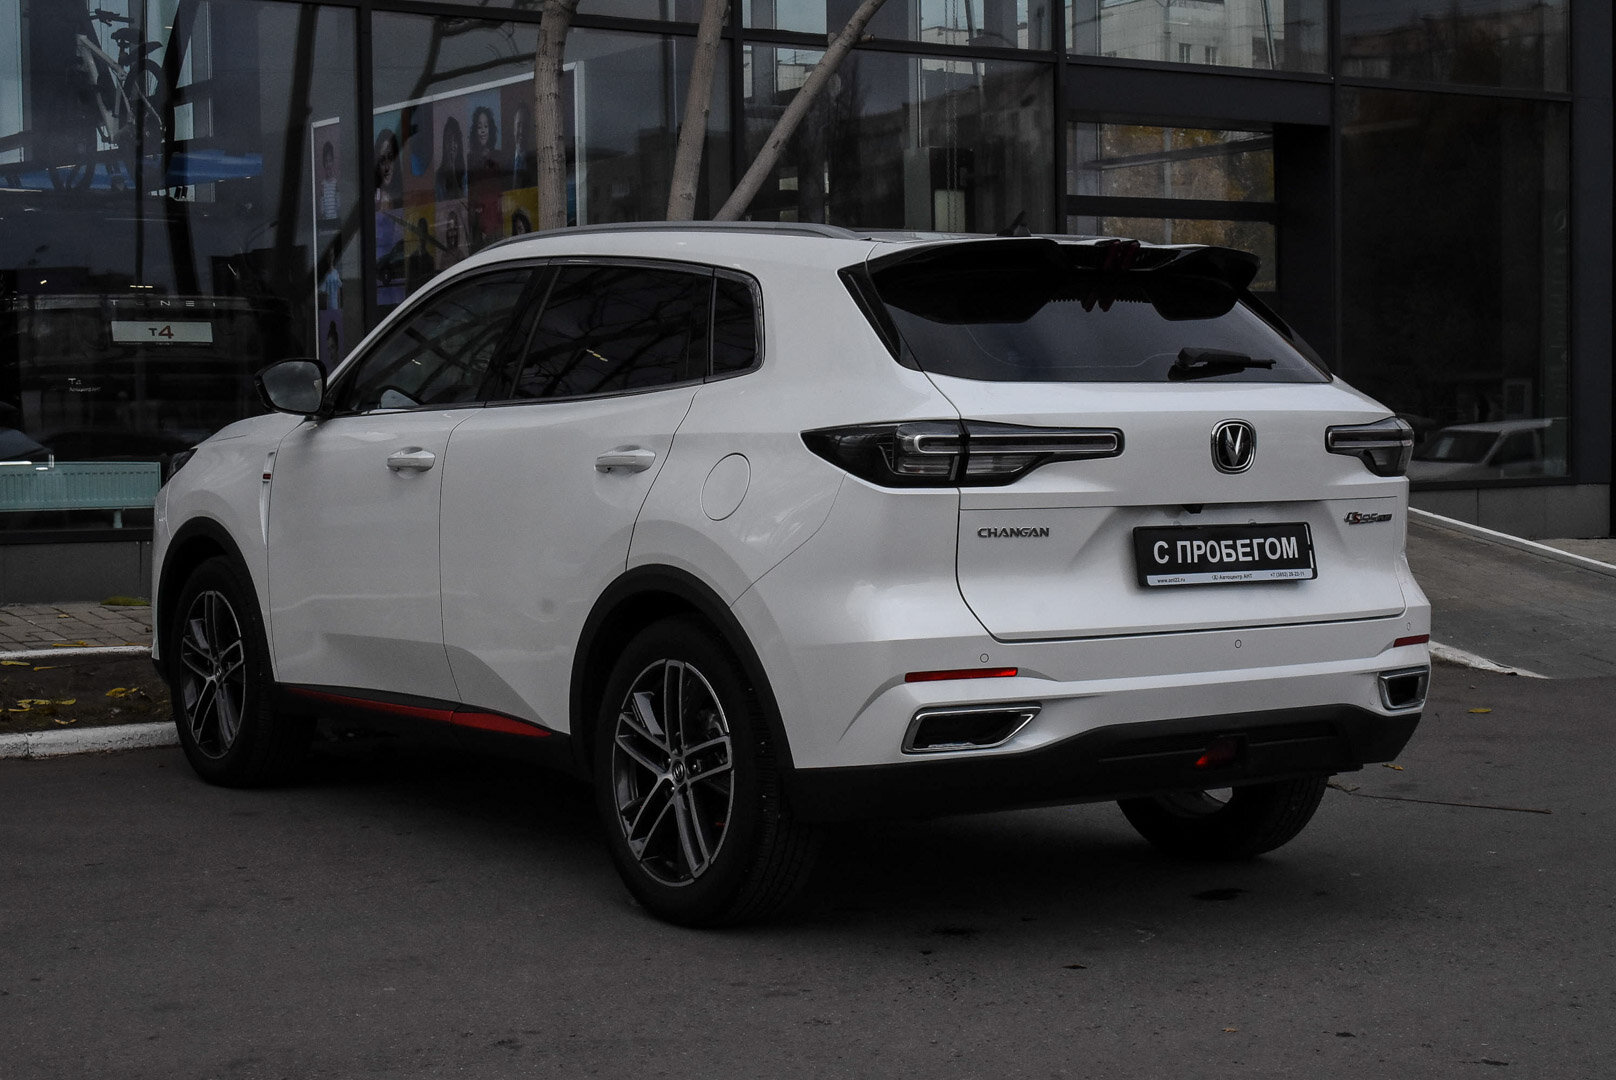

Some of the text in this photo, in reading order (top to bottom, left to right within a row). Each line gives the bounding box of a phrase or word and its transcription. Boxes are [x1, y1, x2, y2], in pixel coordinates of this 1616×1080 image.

[148, 325, 174, 339] T4
[977, 527, 1050, 538] CHANGAN
[1153, 536, 1299, 564] С ПРОБЕГОМ
